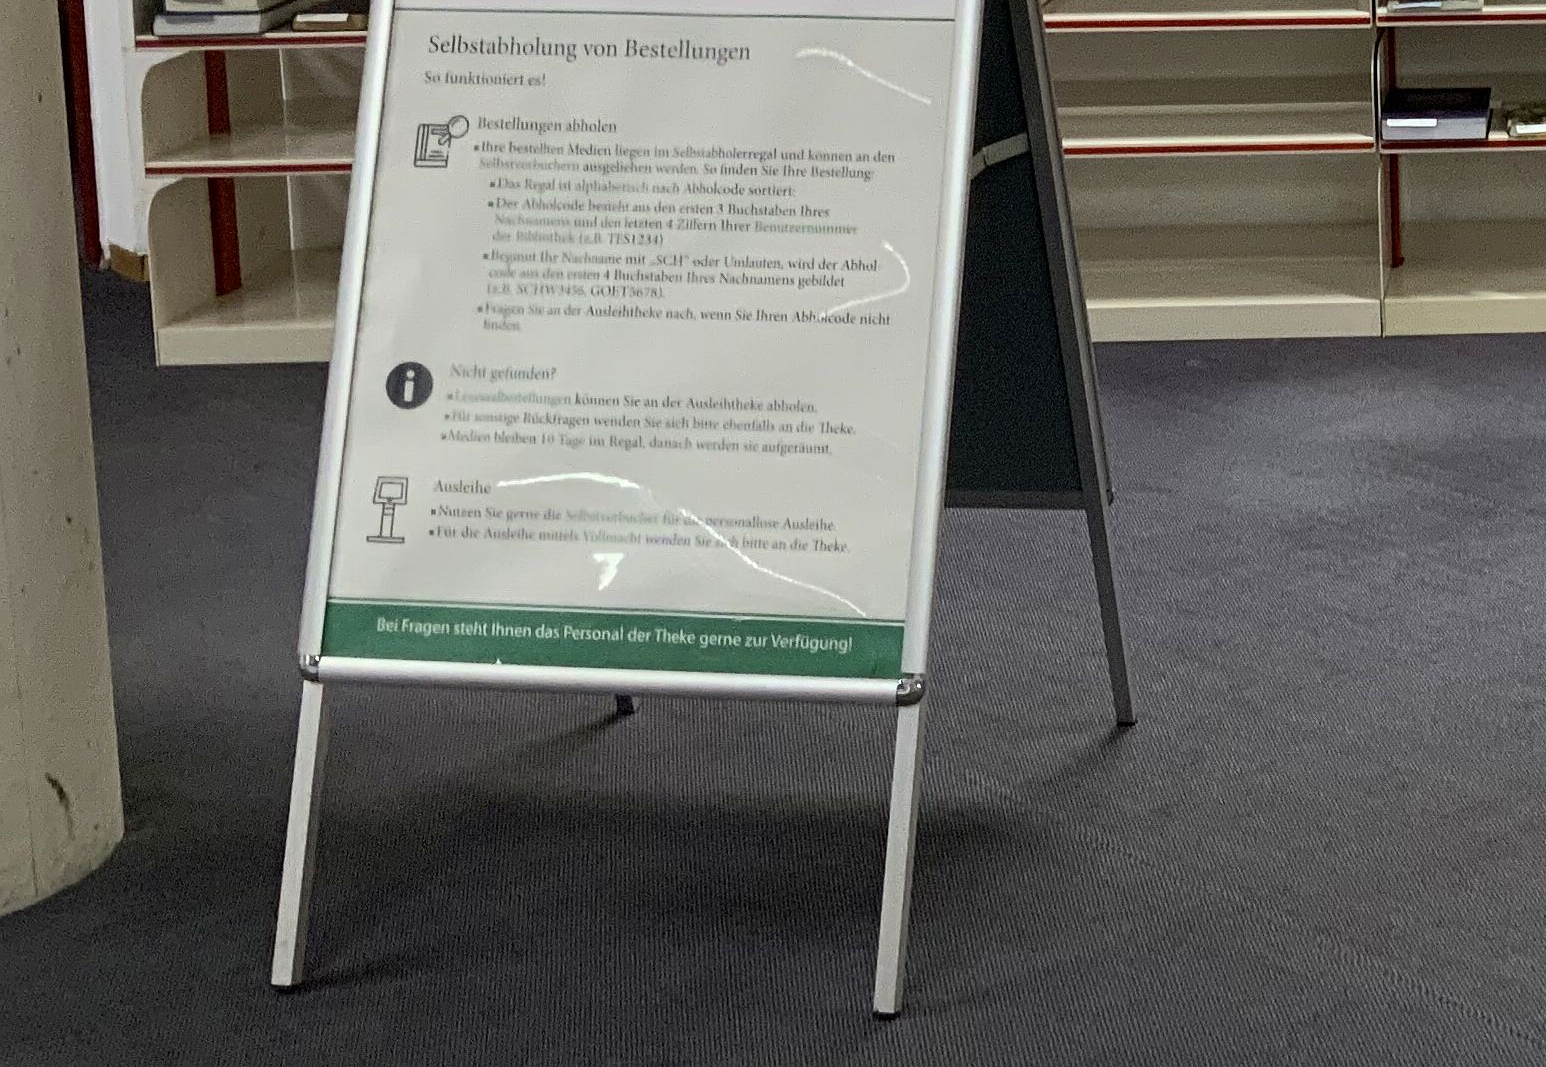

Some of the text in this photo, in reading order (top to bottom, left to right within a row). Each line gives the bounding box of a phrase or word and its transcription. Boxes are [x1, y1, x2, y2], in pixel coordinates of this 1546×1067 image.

[428, 33, 751, 64] Selbstabholung von Bestellungen
[424, 71, 546, 86] So funktioniert es!
[478, 117, 617, 135] Bestellungen abholen
[481, 140, 896, 164] Ihre bestellten Medien liegen im Selbstabholerregal und können an den
[582, 160, 652, 176] ausgeliehen
[702, 164, 717, 175] So
[720, 164, 758, 176] finden
[761, 165, 779, 177] Sie
[783, 165, 807, 178] Ihre
[652, 181, 680, 194] nach
[684, 181, 746, 197] Abholcode
[496, 198, 831, 217] Der Abholcode besteht aus den ersten 3 Buchstaben Ihres
[573, 216, 598, 229] und
[600, 216, 621, 229] den
[624, 217, 663, 231] letzten
[666, 218, 674, 230] 4
[720, 219, 751, 232] Ihrer
[539, 250, 559, 263] Ihr
[562, 251, 622, 265] Nachname
[625, 253, 646, 265] mit
[692, 255, 720, 268] oder
[724, 255, 784, 270] Umlauten,
[787, 257, 815, 270] wird
[817, 258, 838, 271] der
[603, 269, 611, 281] 4
[613, 269, 684, 284] Buchstaben
[686, 270, 716, 284] Ihres
[719, 272, 795, 286] Nachnamens
[798, 273, 846, 290] gebildet
[546, 305, 561, 317] an
[563, 304, 582, 317] der
[585, 305, 663, 319] Ausleihtheke
[700, 310, 732, 323] wenn
[735, 309, 753, 323] Sie
[755, 309, 788, 323] Ihren
[859, 312, 891, 327] nicht
[449, 362, 558, 383] Nicht gefunden?
[574, 392, 818, 414] können Sie an der Ausleihtheke abholen.
[523, 411, 590, 429] Rückfragen
[594, 415, 641, 429] wenden
[644, 416, 664, 430] Sie
[665, 416, 689, 430] sich
[692, 416, 720, 431] bitte
[722, 418, 776, 433] ebenfalls
[778, 421, 793, 434] an
[795, 420, 814, 434] die
[818, 421, 856, 436] Theke.
[446, 429, 491, 443] Medien
[494, 431, 537, 445] bleiben
[558, 433, 586, 449] Tage
[588, 436, 605, 447] im
[649, 436, 693, 451] danach
[695, 438, 740, 453] werden
[433, 479, 493, 495] Ausleihe
[437, 503, 482, 519] Nutzen
[485, 506, 504, 520] Sie
[506, 509, 541, 523] gerne
[543, 508, 562, 521] die
[661, 512, 680, 526] für
[436, 525, 457, 538] Für
[460, 526, 481, 540] die
[484, 527, 535, 542] Ausleihe
[538, 528, 579, 543] mittels
[645, 532, 692, 547] wenden
[694, 534, 711, 548] Sie
[741, 536, 769, 551] bitte
[771, 540, 787, 552] an
[789, 538, 809, 552] die
[376, 617, 854, 655] Bei Fragen steht Ihnen das Personal der Theke gerne zur Verfügung!
